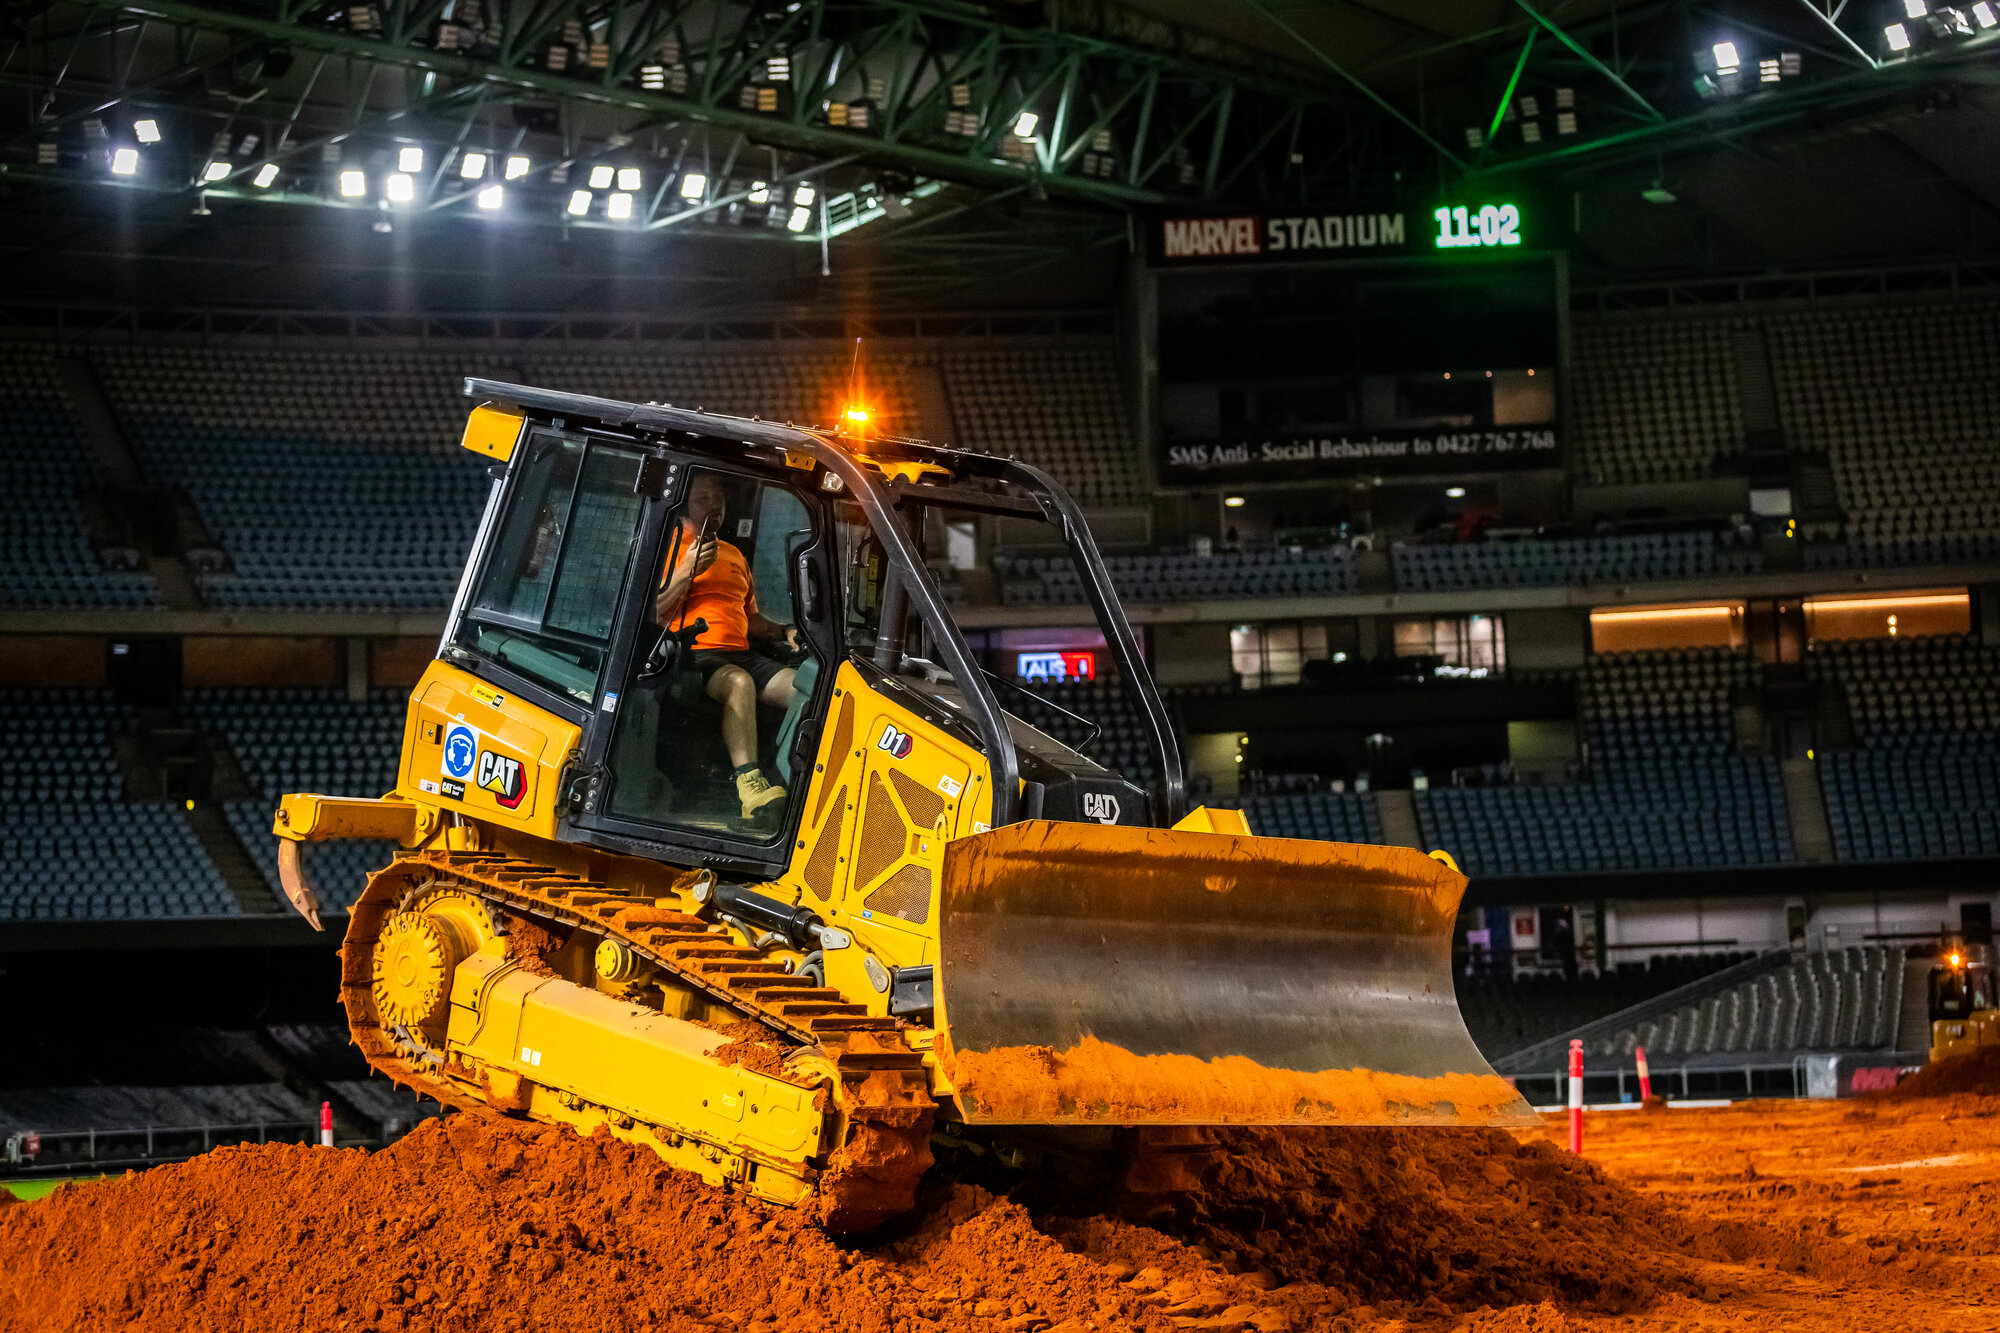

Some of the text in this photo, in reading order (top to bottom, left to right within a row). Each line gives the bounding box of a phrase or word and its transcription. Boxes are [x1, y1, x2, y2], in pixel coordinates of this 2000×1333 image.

[1164, 213, 1405, 257] MARVEL STADIUM
[1435, 204, 1521, 247] 11:02
[1169, 446, 1207, 466] SMS
[1212, 442, 1248, 465] Anti
[1262, 438, 1313, 462] Social
[1319, 435, 1408, 458] Behaviour
[1413, 436, 1432, 456] to
[1436, 434, 1481, 454] 0427
[877, 724, 906, 755] D1
[477, 750, 519, 797] CAT
[1084, 792, 1110, 818] CAT
